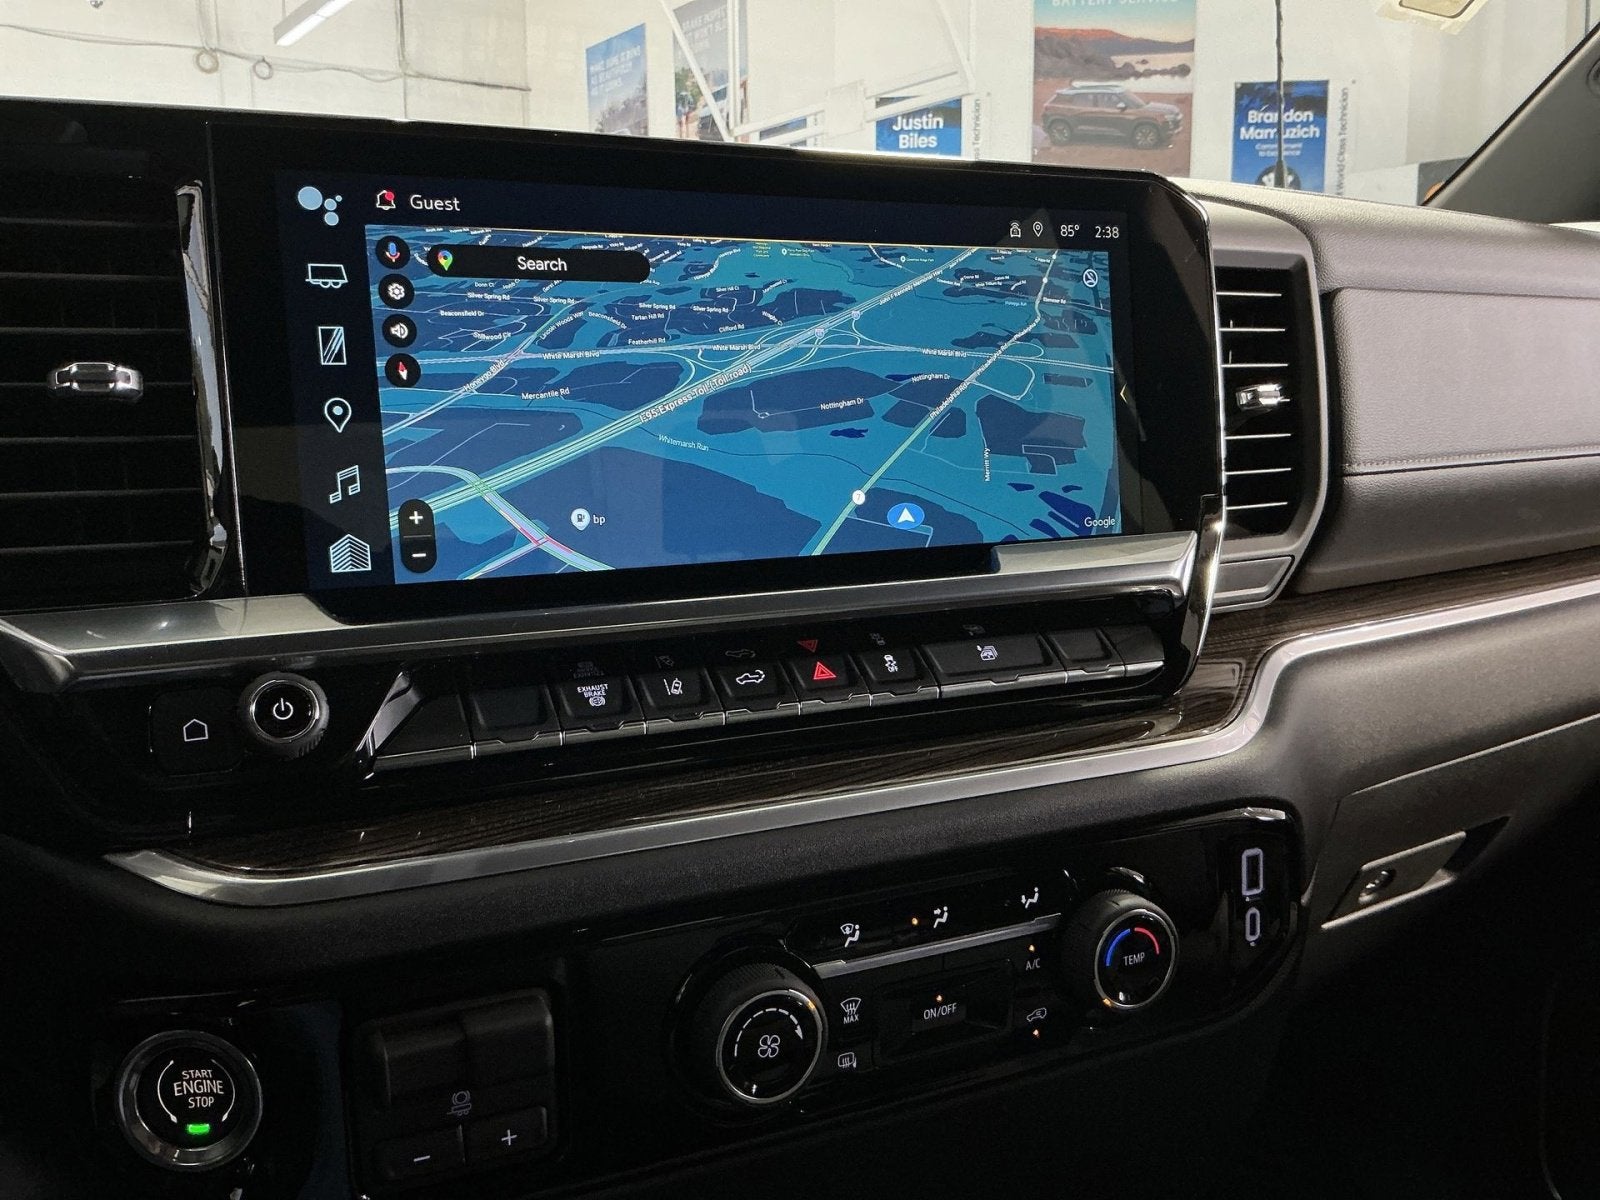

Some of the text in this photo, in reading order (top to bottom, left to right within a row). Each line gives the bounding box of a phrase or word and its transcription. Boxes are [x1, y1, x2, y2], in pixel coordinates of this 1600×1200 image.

[892, 114, 944, 132] Justin
[898, 133, 938, 149] Biles
[410, 194, 460, 211] Guest
[1060, 224, 1080, 237] 85°
[1095, 226, 1120, 238] 2:38
[517, 256, 568, 271] Search
[588, 312, 622, 327] Beaconsfield
[473, 331, 502, 341] Stillwood
[464, 368, 492, 391] Honeygo
[912, 374, 944, 383] Nottingham
[522, 387, 570, 400] Mercantile Rd
[658, 394, 692, 414] Express
[693, 384, 709, 397] Toll
[730, 363, 752, 380] road)
[820, 399, 855, 410] Nottingham
[930, 388, 960, 418] Philadelphia
[658, 434, 709, 451] Whitemarsh Run
[984, 448, 990, 460] Wy
[593, 514, 606, 526] bp
[1085, 516, 1116, 529] Google
[577, 684, 608, 693] EXHAUST
[584, 690, 606, 698] BRAKE
[1025, 958, 1040, 971] A/C
[1123, 952, 1146, 967] TEMP
[923, 1002, 958, 1020] ON/OFF
[844, 1014, 859, 1024] MAX
[182, 1070, 213, 1080] START
[173, 1080, 224, 1096] ENGINE
[188, 1097, 214, 1109] STOP
